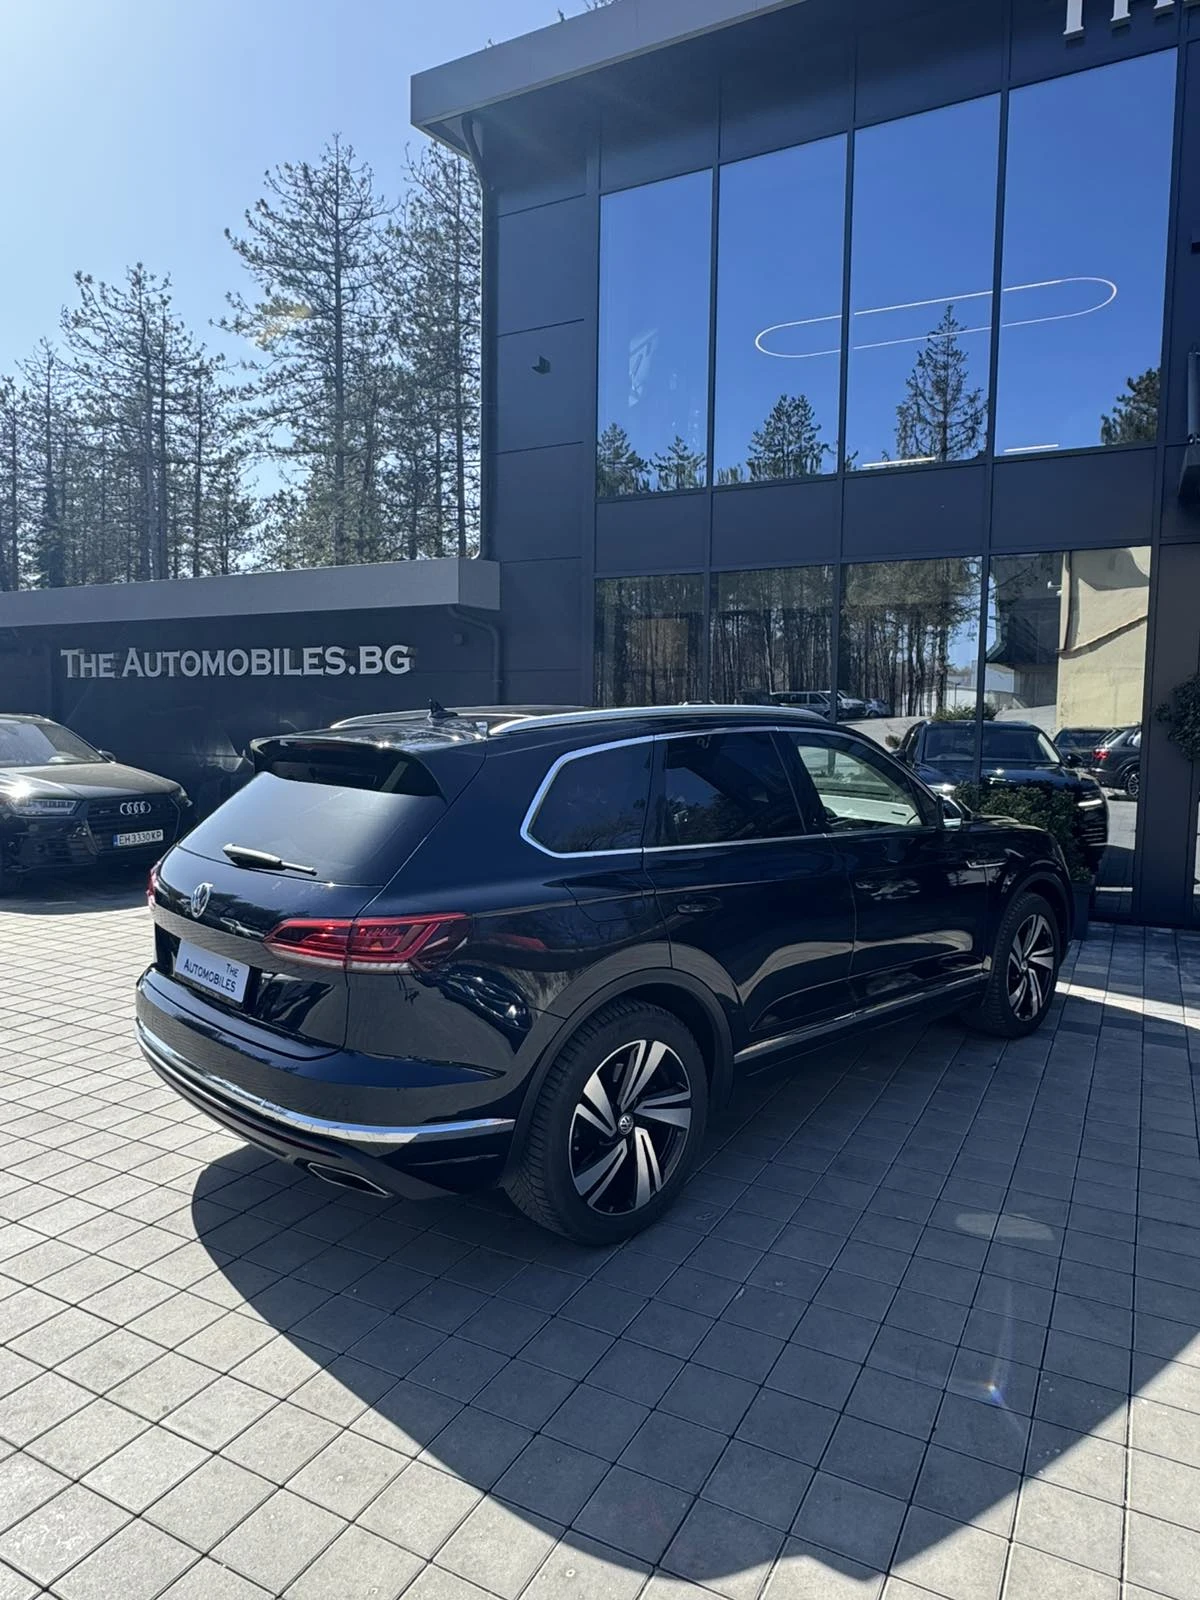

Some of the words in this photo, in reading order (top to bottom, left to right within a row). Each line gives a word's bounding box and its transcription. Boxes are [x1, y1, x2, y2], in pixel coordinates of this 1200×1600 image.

[60, 649, 115, 678] THE
[121, 645, 411, 678] AUTOMOBILES.BG
[183, 958, 237, 993] AUTOMOBILES
[225, 963, 239, 978] THE
